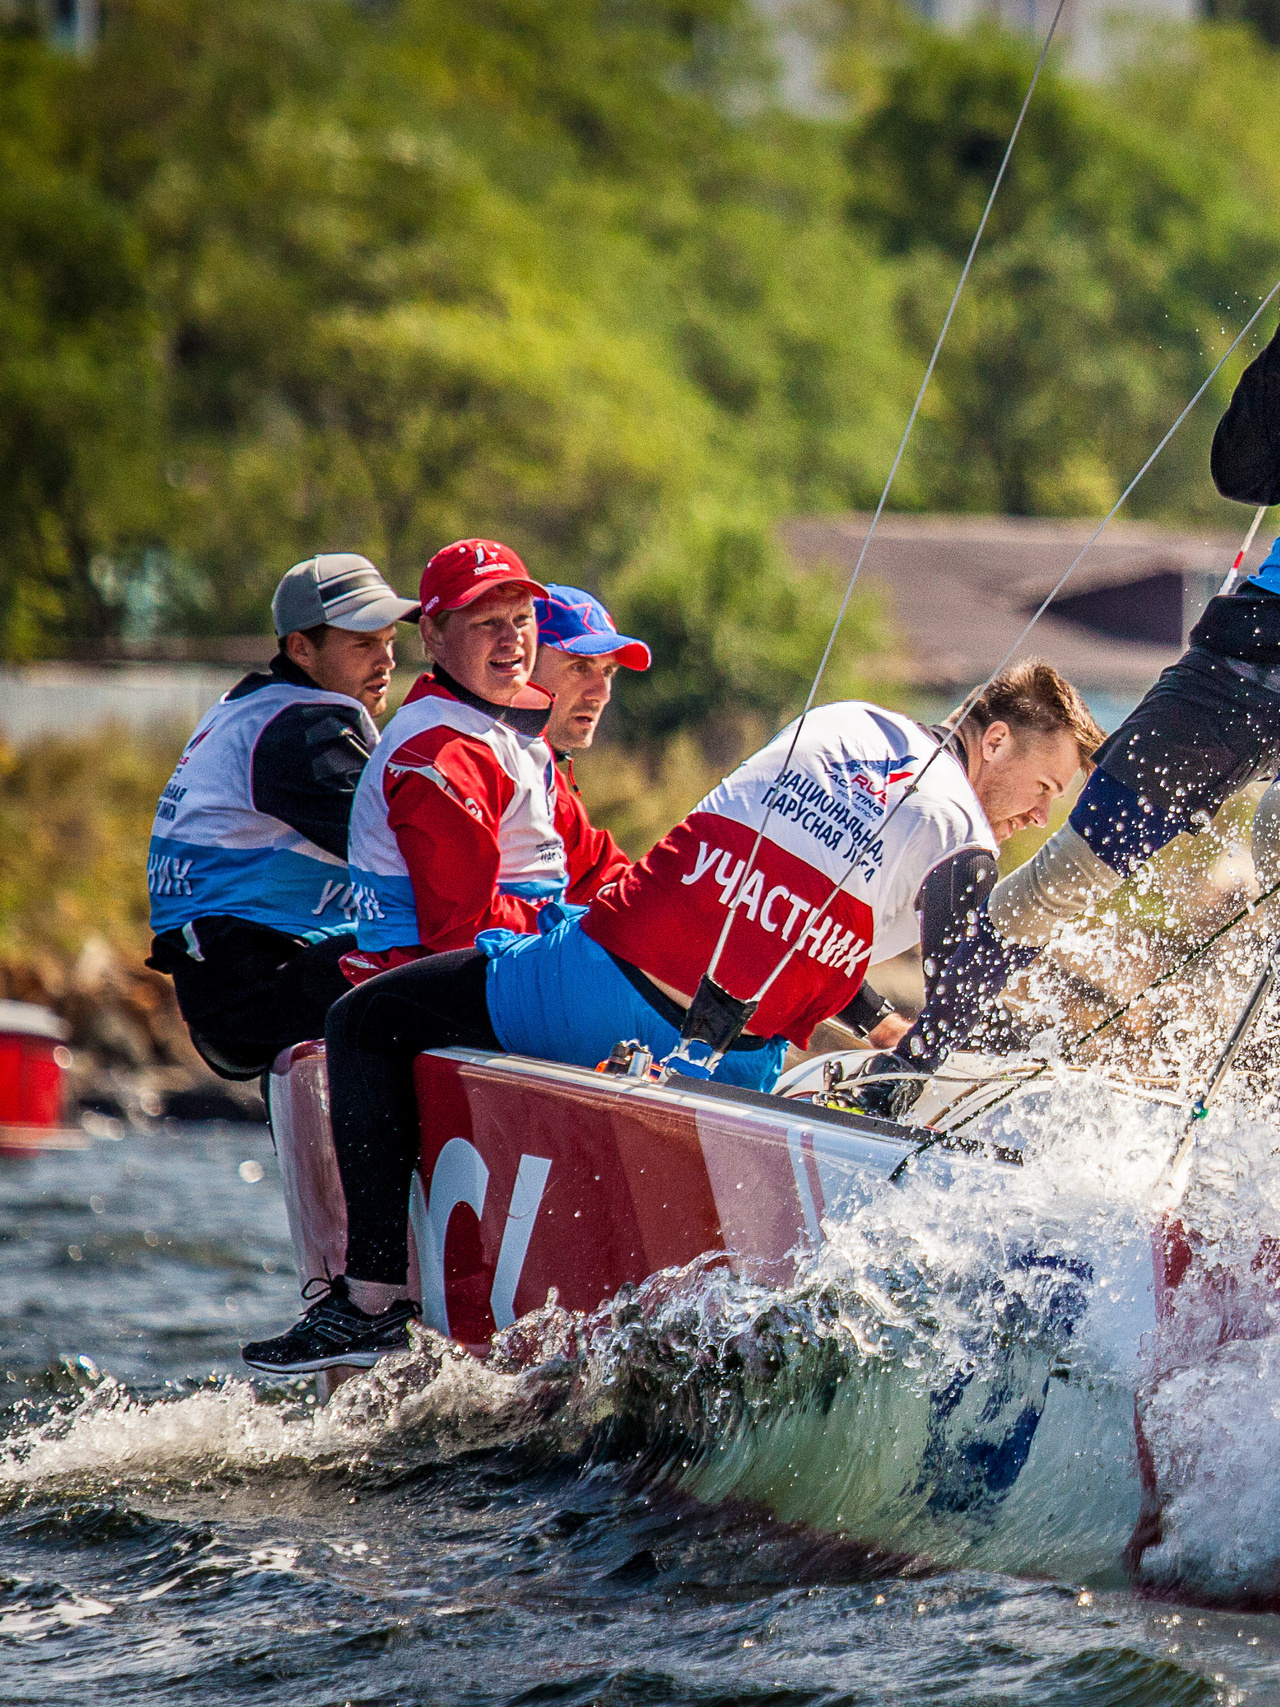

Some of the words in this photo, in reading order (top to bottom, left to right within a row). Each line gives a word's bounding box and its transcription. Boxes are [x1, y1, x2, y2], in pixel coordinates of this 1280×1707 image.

[760, 786, 844, 851] ПАРУСНАЯ
[822, 763, 884, 816] YACTING
[680, 841, 872, 978] УЧАСТНИК
